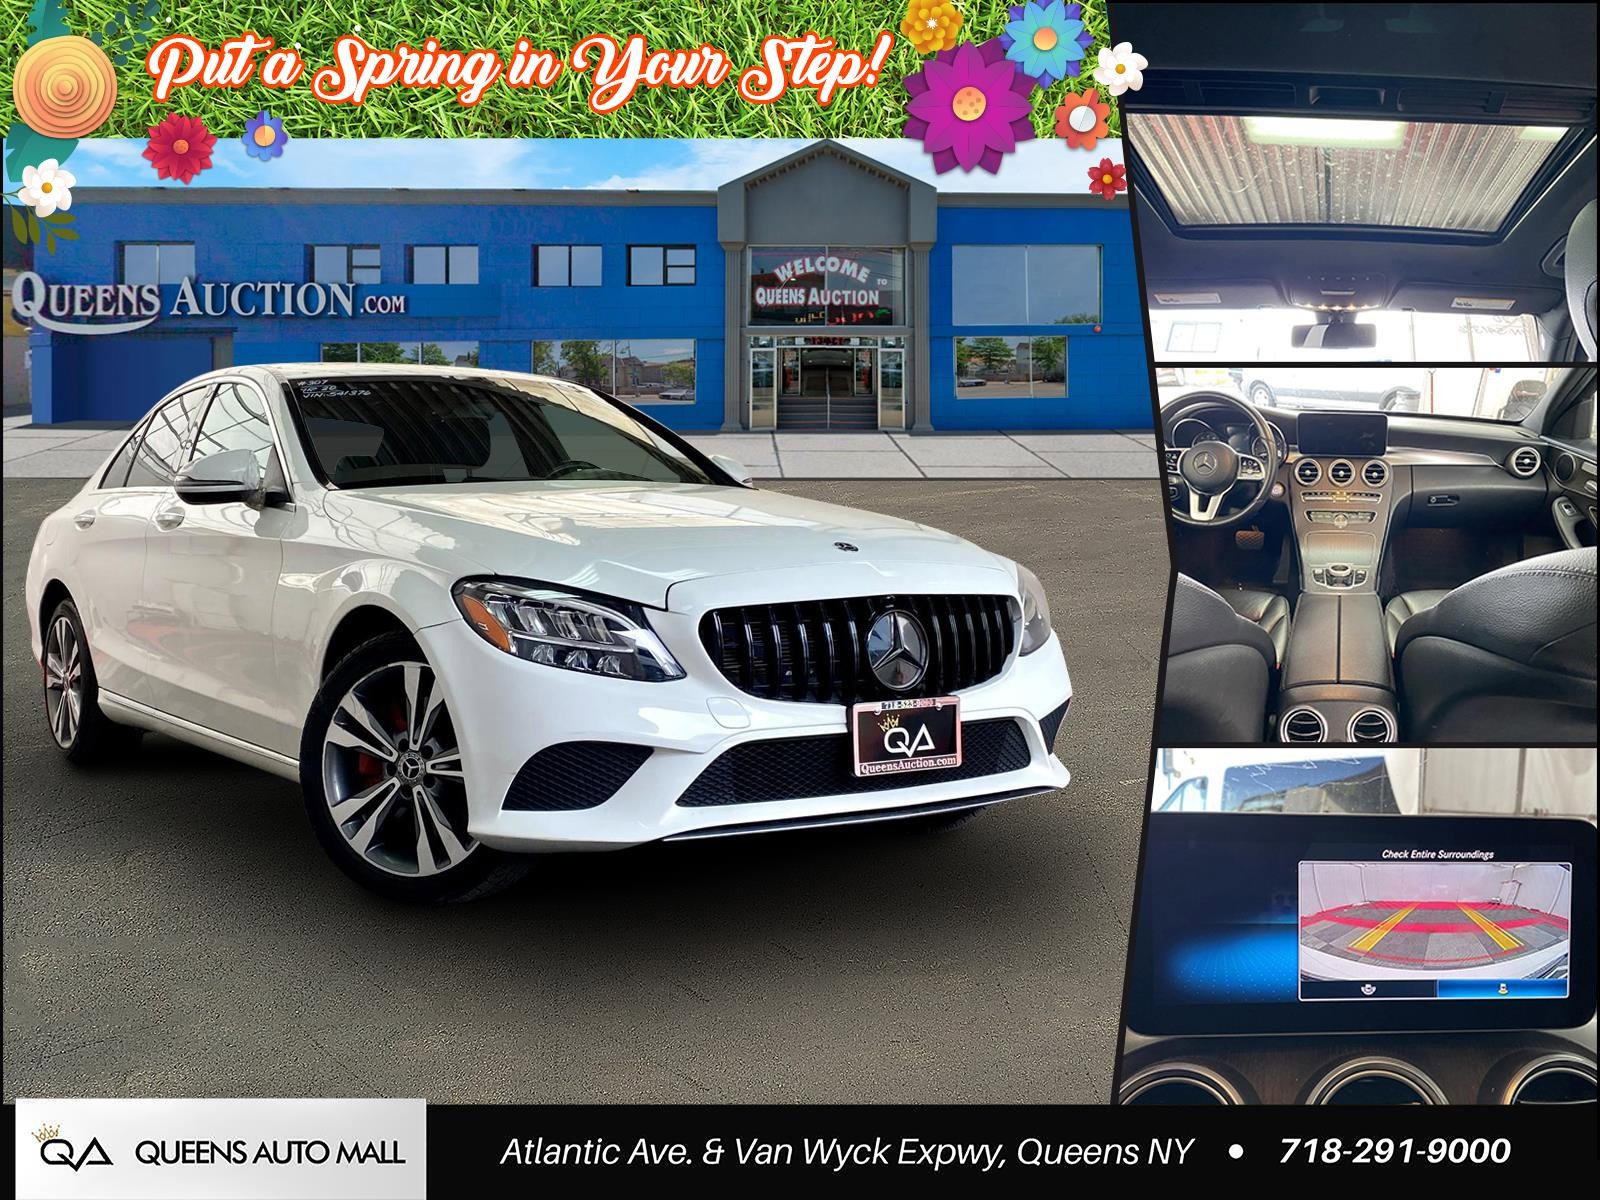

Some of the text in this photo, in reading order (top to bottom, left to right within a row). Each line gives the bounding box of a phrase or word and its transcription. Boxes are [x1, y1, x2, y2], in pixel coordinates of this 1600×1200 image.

[774, 256, 870, 283] WELCOME
[11, 271, 161, 335] QUEENS
[755, 287, 880, 307] QUEENS AUCTION
[884, 723, 935, 757] QA
[861, 757, 956, 774] QueensAuction.com
[1382, 849, 1494, 860] Check Entire Surroundings
